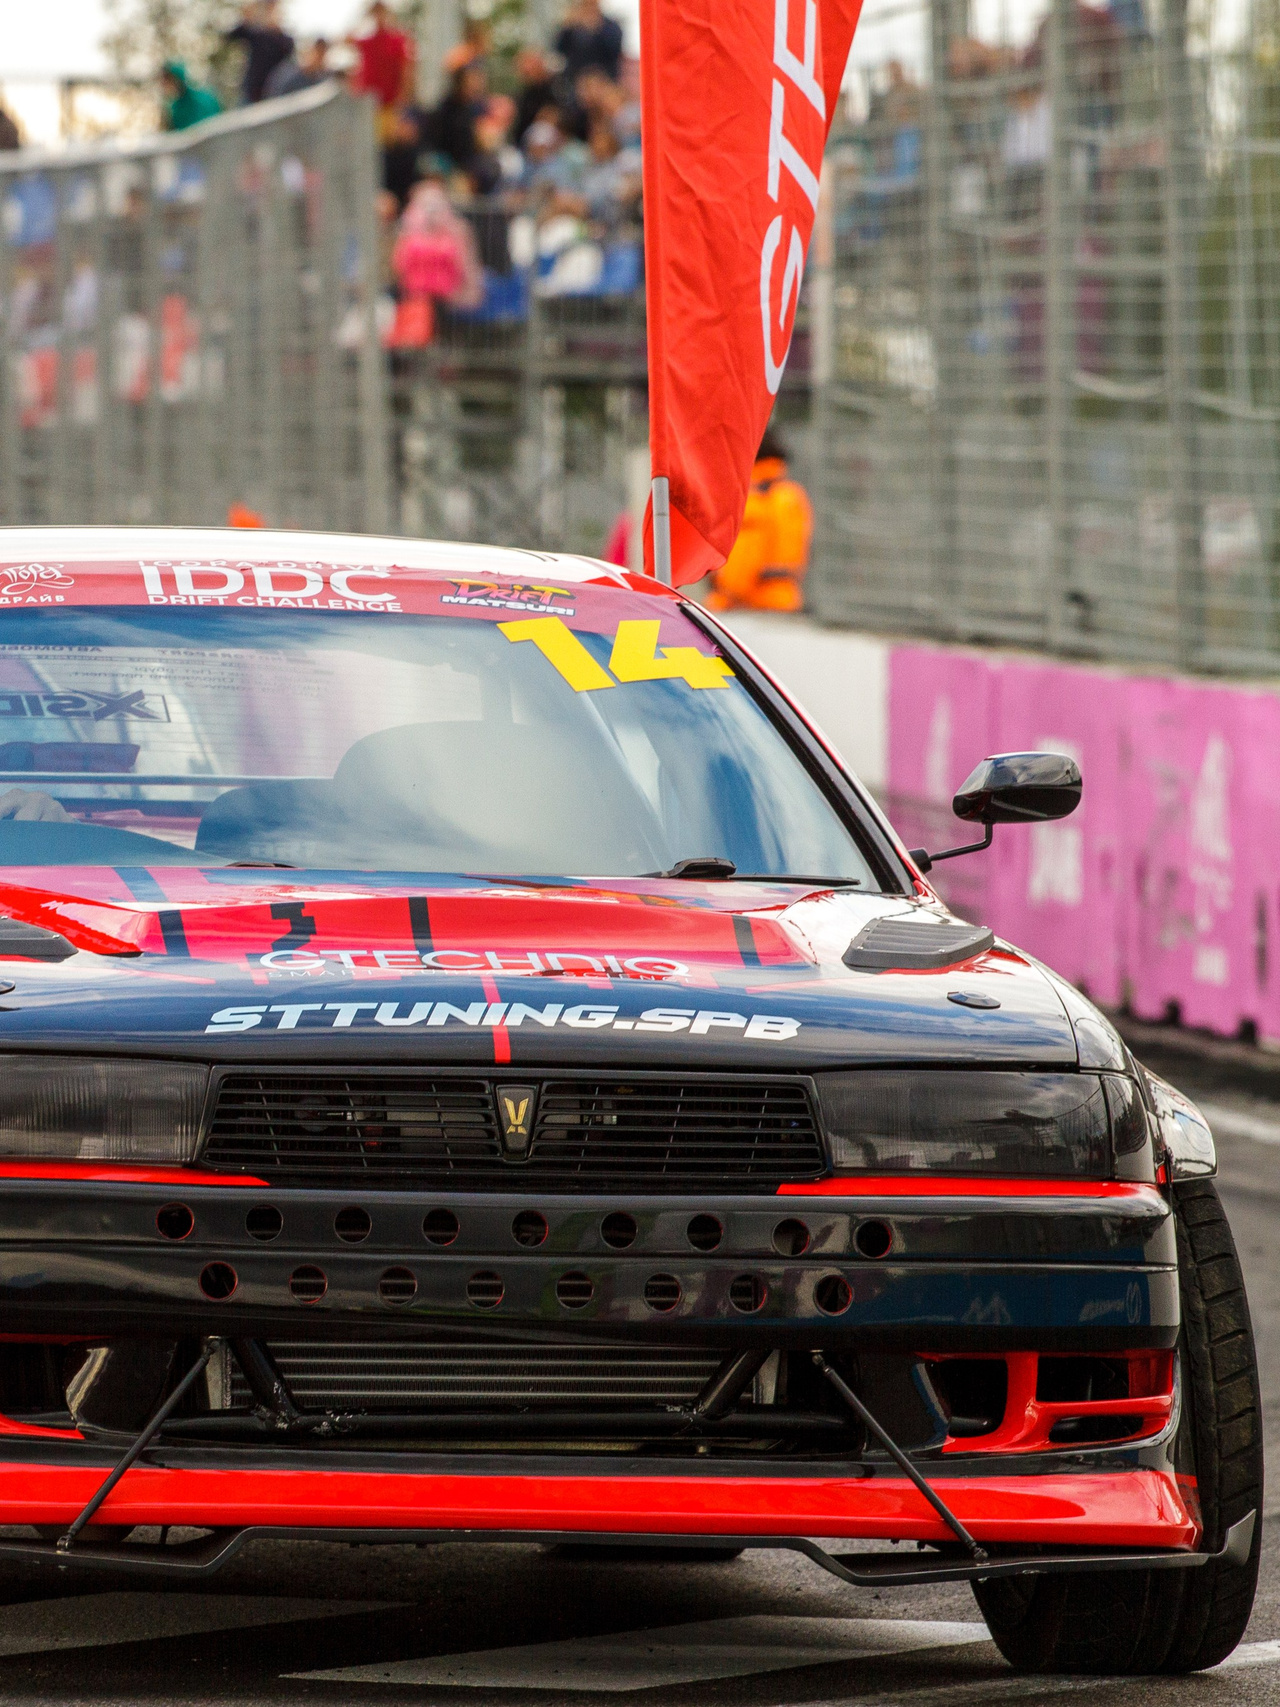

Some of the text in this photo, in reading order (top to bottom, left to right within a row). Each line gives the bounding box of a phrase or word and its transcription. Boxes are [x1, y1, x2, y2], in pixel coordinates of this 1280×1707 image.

[140, 565, 397, 602] IDDC
[148, 594, 404, 613] DRIFT CHALLENGE
[441, 595, 575, 616] MATSURI
[496, 616, 736, 692] 14
[205, 1002, 802, 1041] STTUNING.SPB
